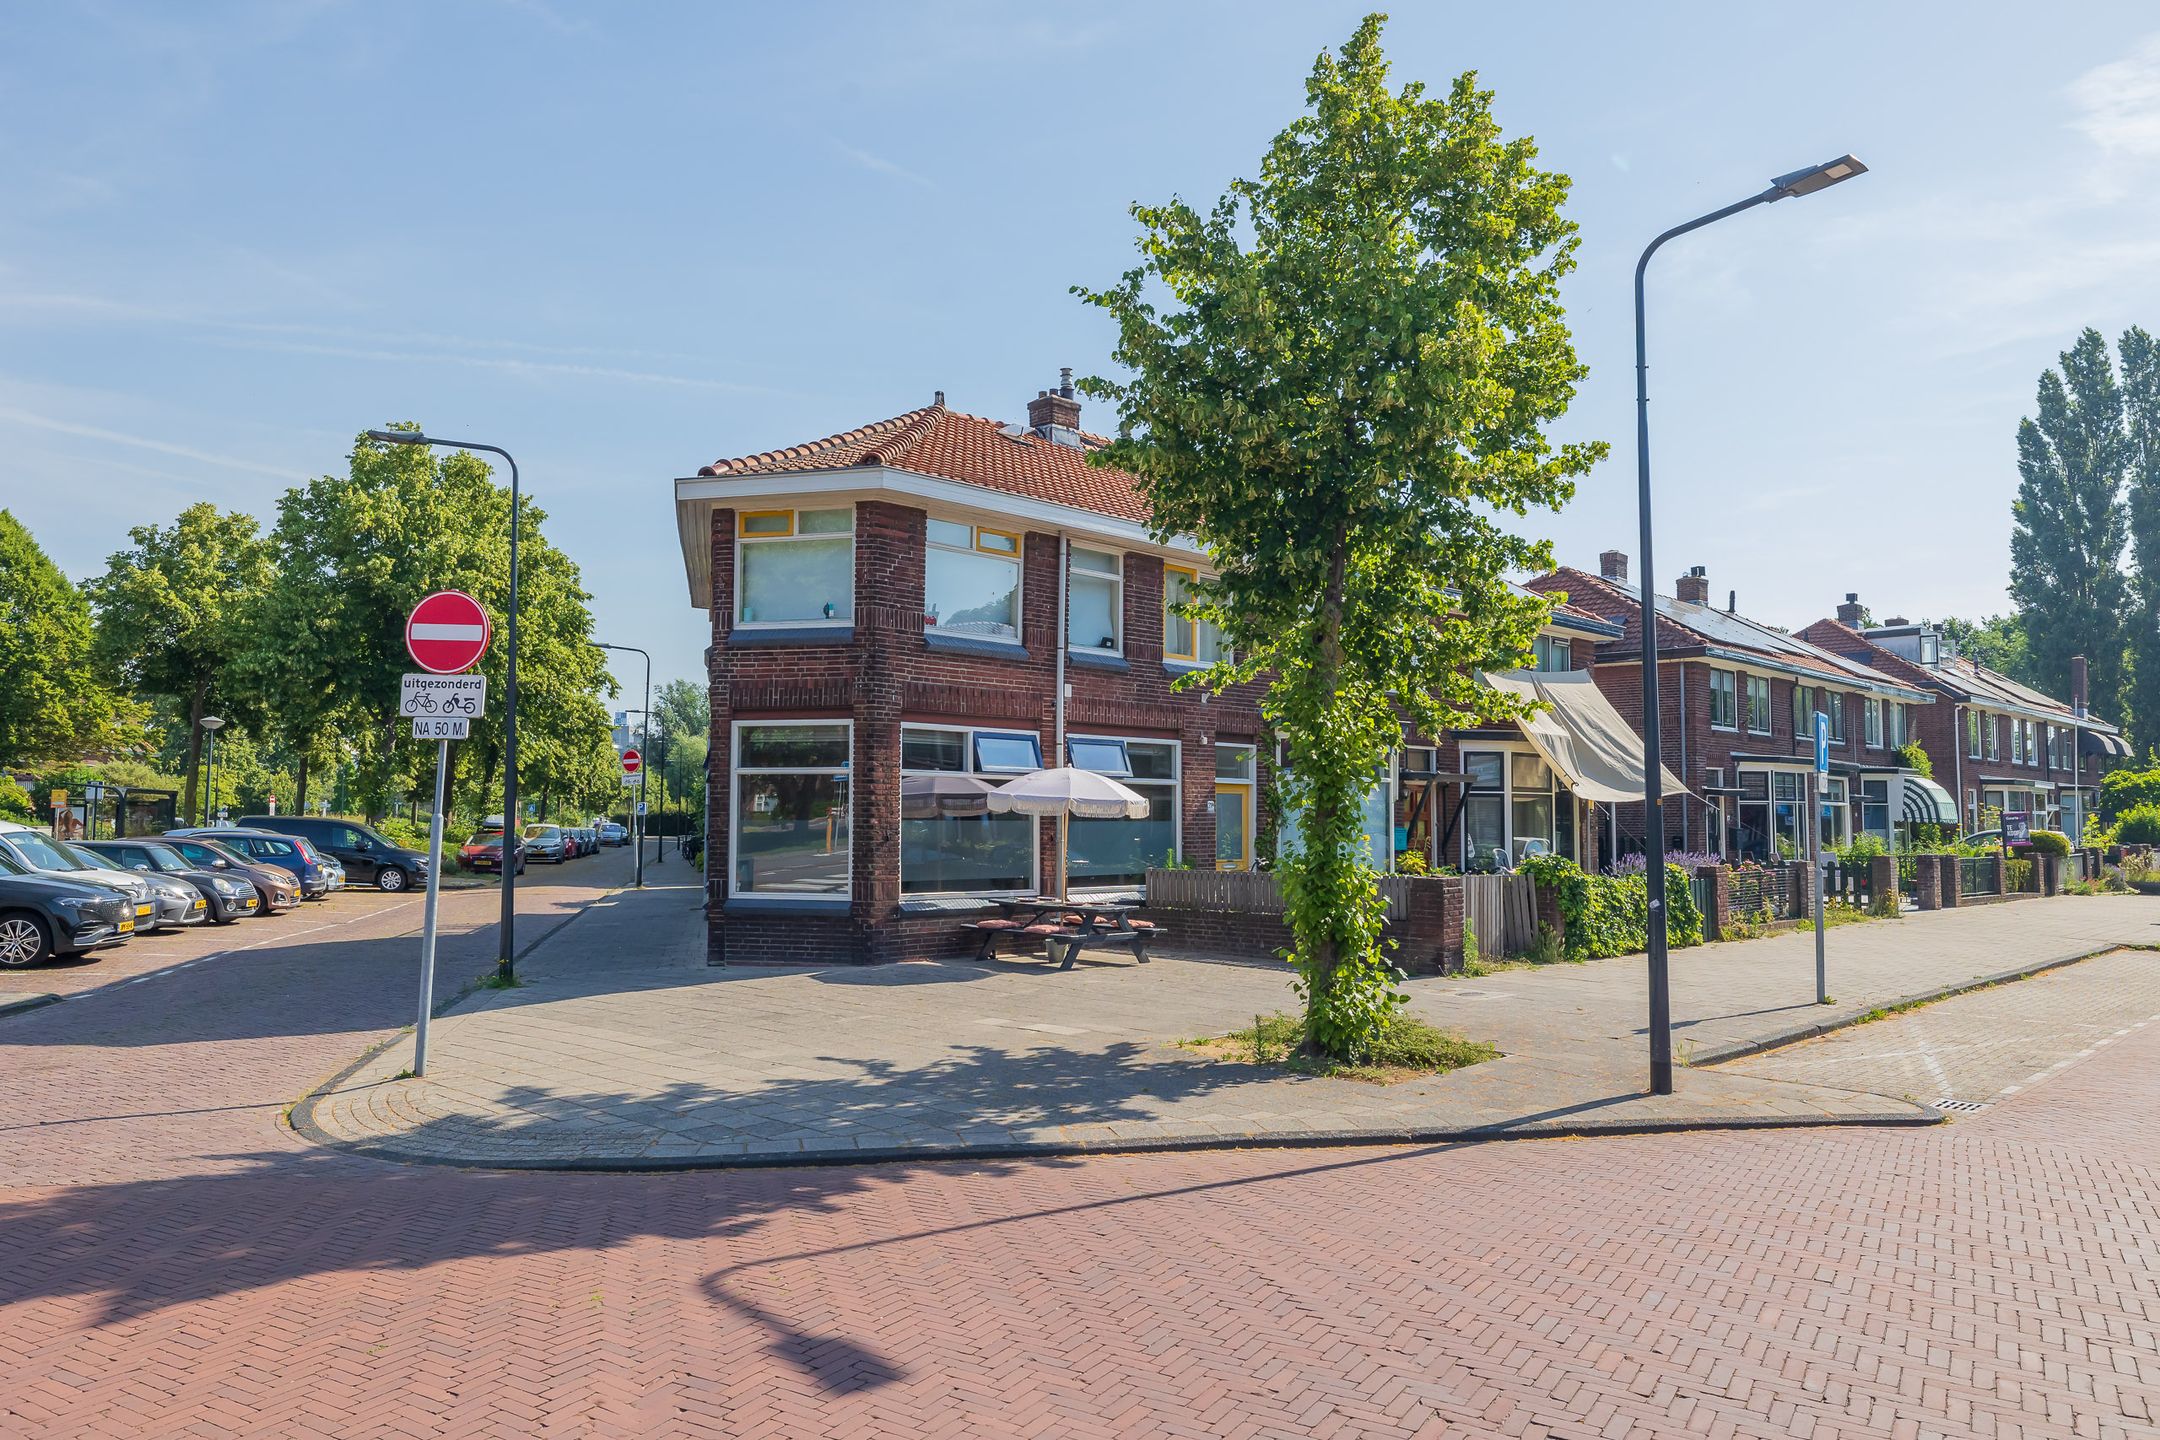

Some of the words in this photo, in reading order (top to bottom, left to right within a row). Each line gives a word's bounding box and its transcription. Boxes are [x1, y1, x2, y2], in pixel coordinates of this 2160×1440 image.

[404, 678, 481, 691] uitgezonderd
[414, 721, 430, 735] NA
[434, 722, 449, 736] 50
[452, 722, 464, 736] M.
[1820, 721, 1827, 765] P
